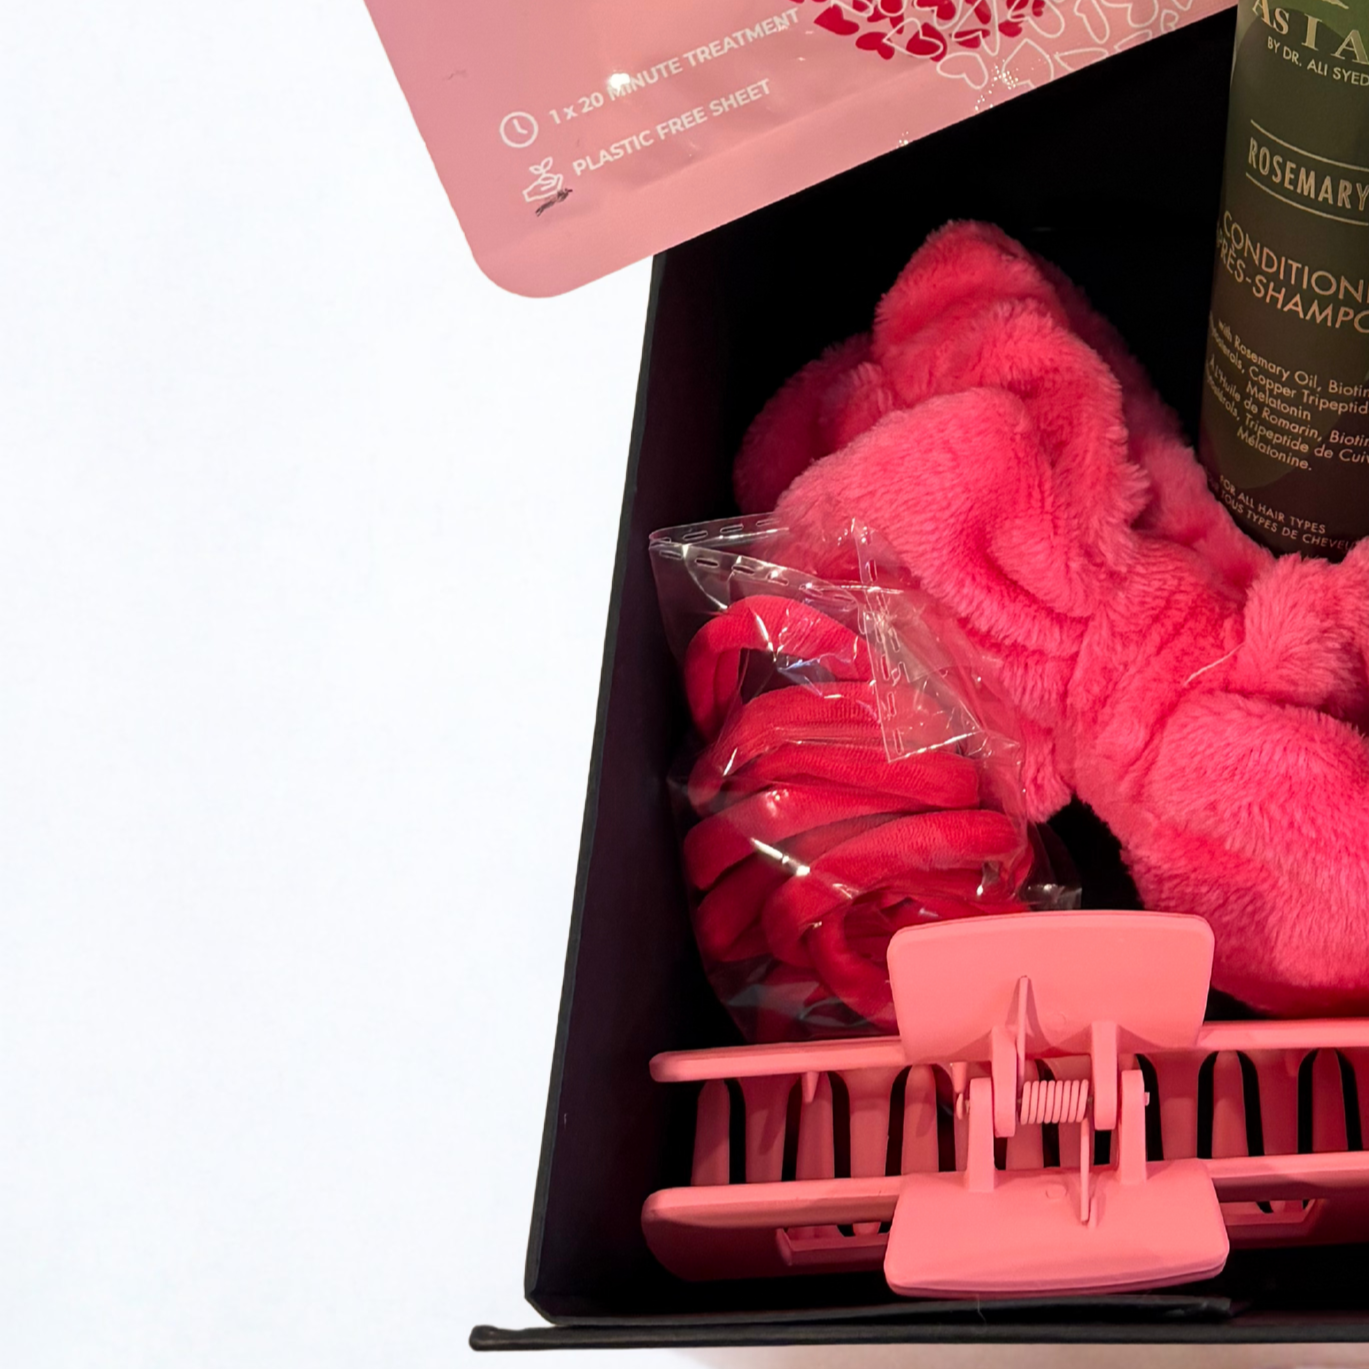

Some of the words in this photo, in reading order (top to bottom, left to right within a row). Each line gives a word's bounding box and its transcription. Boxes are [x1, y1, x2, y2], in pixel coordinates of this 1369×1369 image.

[1301, 13, 1322, 51] I
[549, 109, 562, 125] 1
[564, 105, 579, 120] x
[578, 91, 605, 114] 20
[683, 7, 800, 67] TREATMENT
[1267, 36, 1281, 53] BY
[1283, 46, 1302, 66] DR.
[1307, 59, 1327, 76] ALI
[572, 129, 655, 176] PLASTIC
[656, 107, 708, 141] FREE
[709, 78, 772, 117] SHEET
[1234, 335, 1290, 381] Rosemary
[1294, 371, 1322, 391] Oil,
[1249, 366, 1296, 398] Copper
[1246, 381, 1311, 420] Melatonin
[1245, 413, 1309, 453] Tripeptide
[1314, 445, 1333, 459] de
[1262, 407, 1322, 442] Romarin,
[1237, 426, 1312, 471] Mélatonine.
[1247, 510, 1278, 533] TYPES
[1258, 503, 1285, 523] HAIR
[1290, 516, 1326, 534] TYPES
